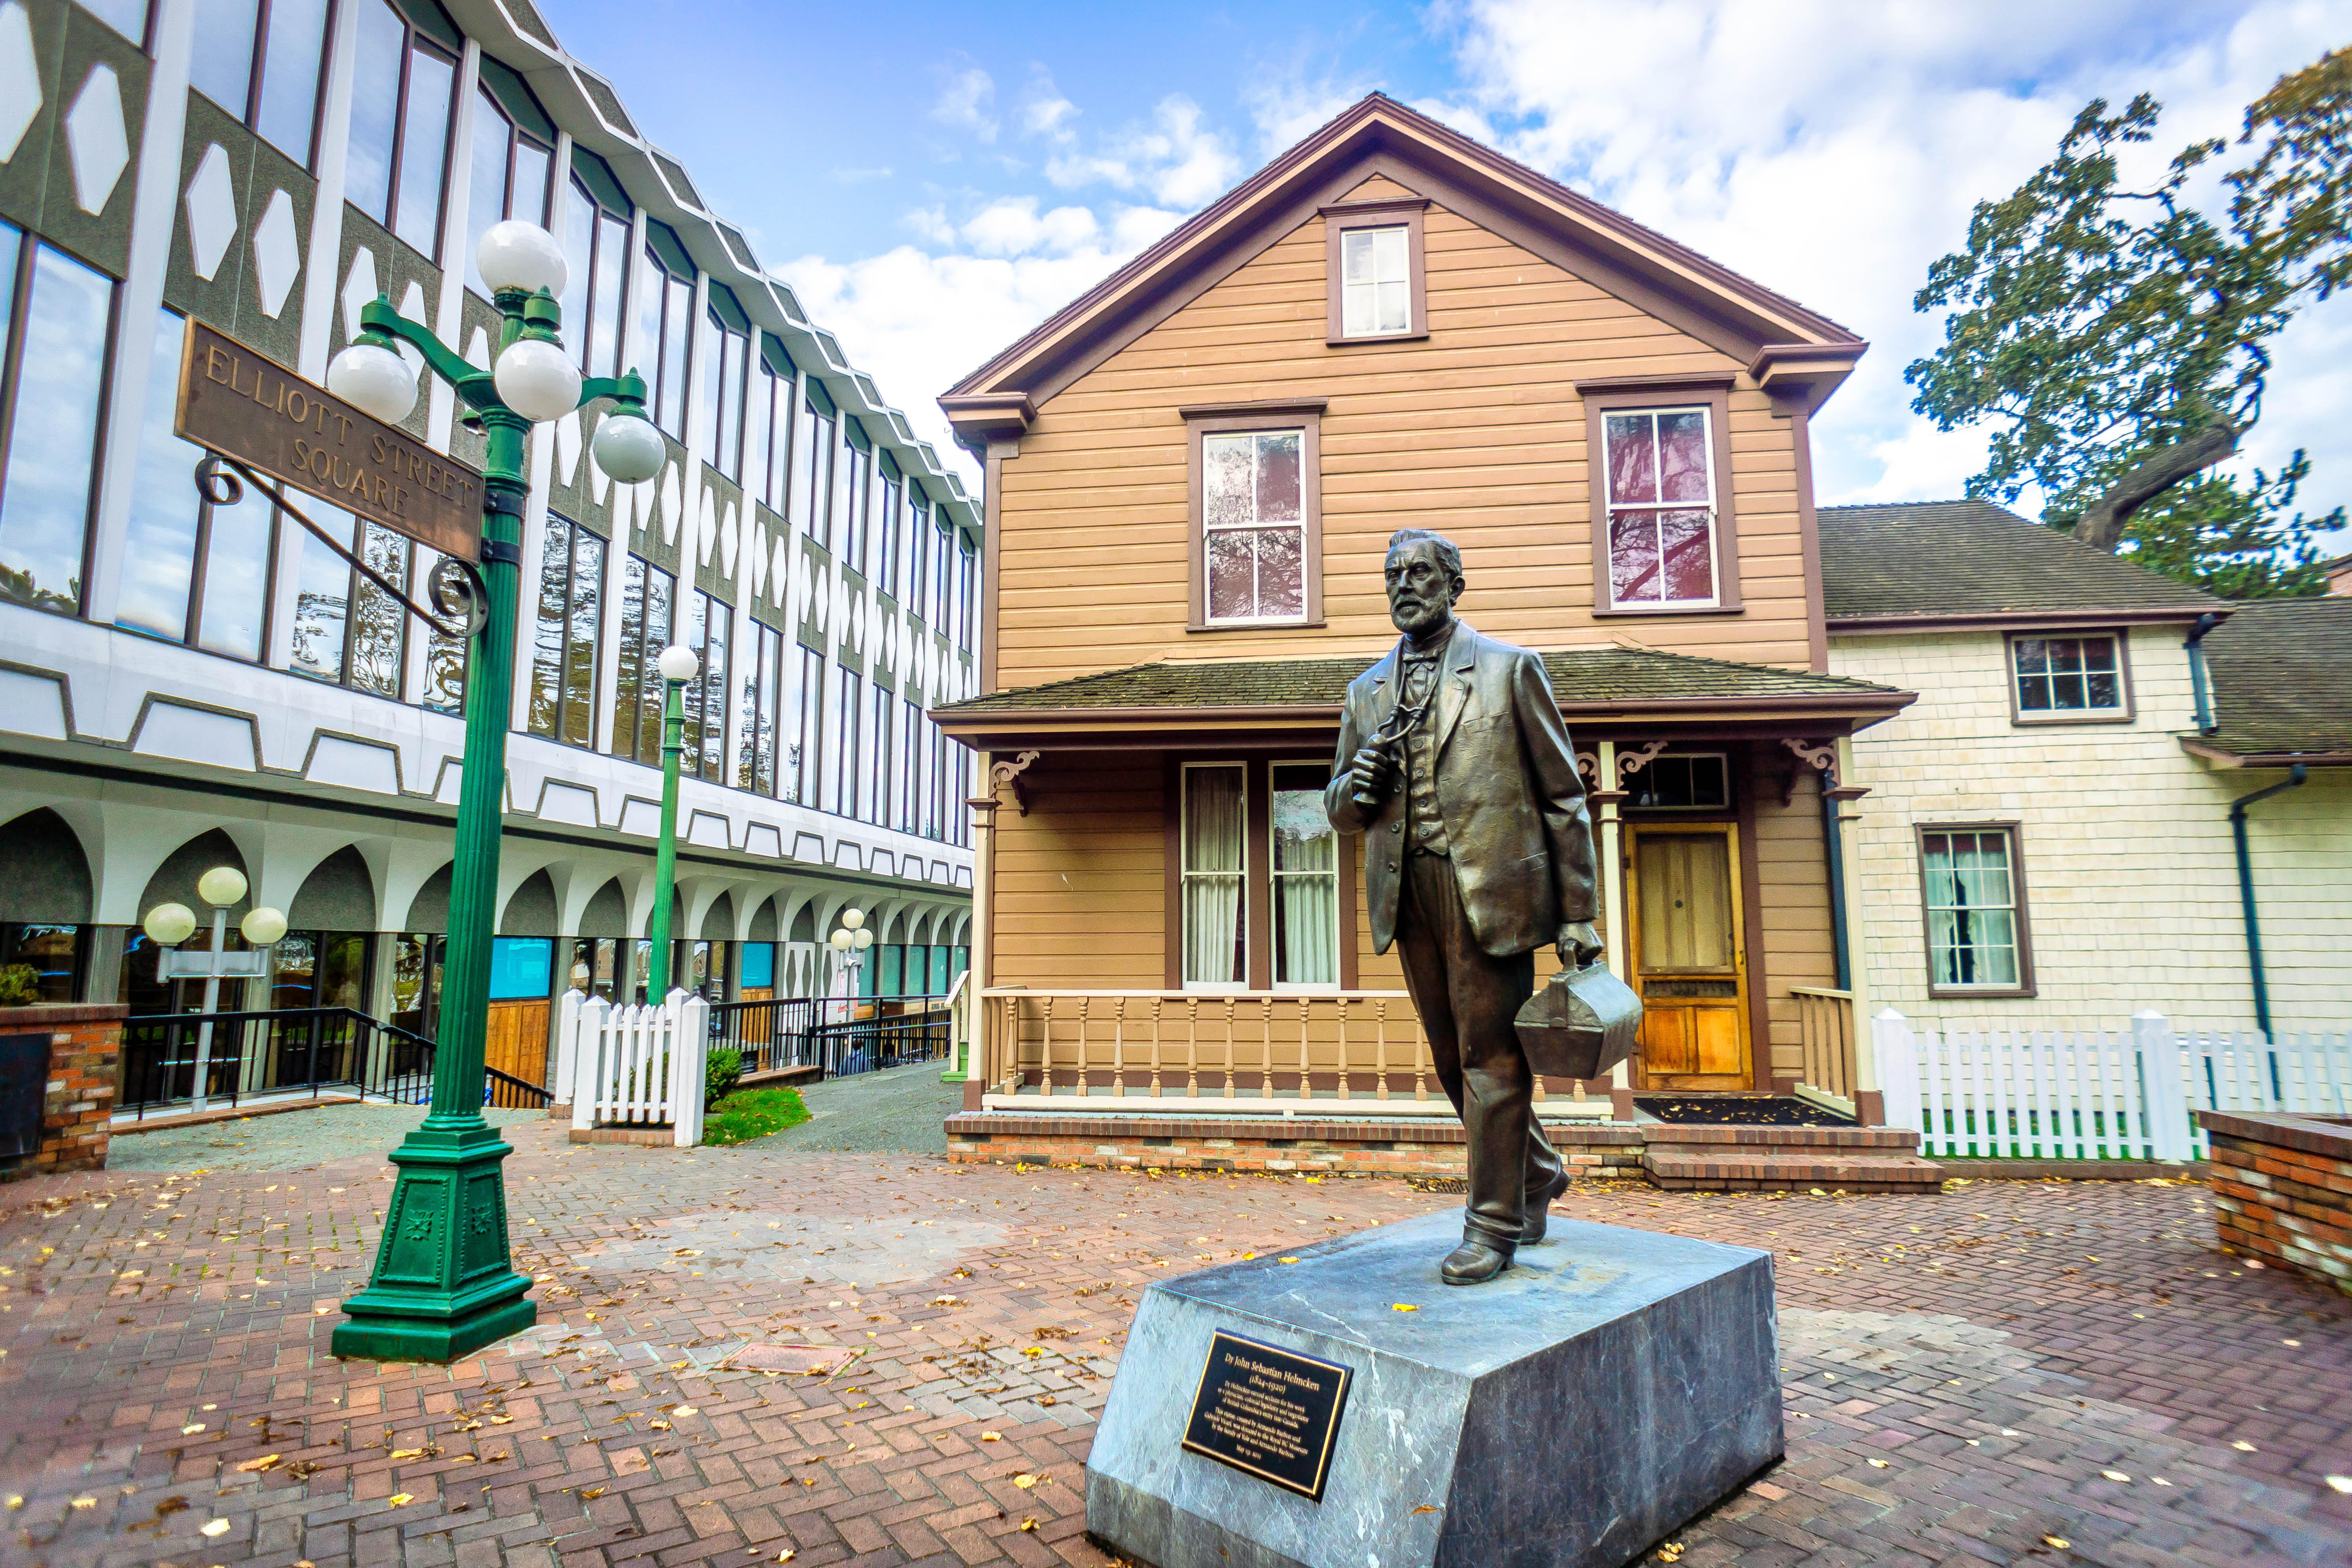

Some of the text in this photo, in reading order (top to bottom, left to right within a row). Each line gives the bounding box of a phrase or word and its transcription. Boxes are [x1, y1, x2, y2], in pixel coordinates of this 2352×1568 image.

[205, 344, 474, 508] ELLIOTT STREET
[291, 439, 409, 518] SQUARE
[1225, 1353, 1320, 1392] Dr John Sebastian Helmcken
